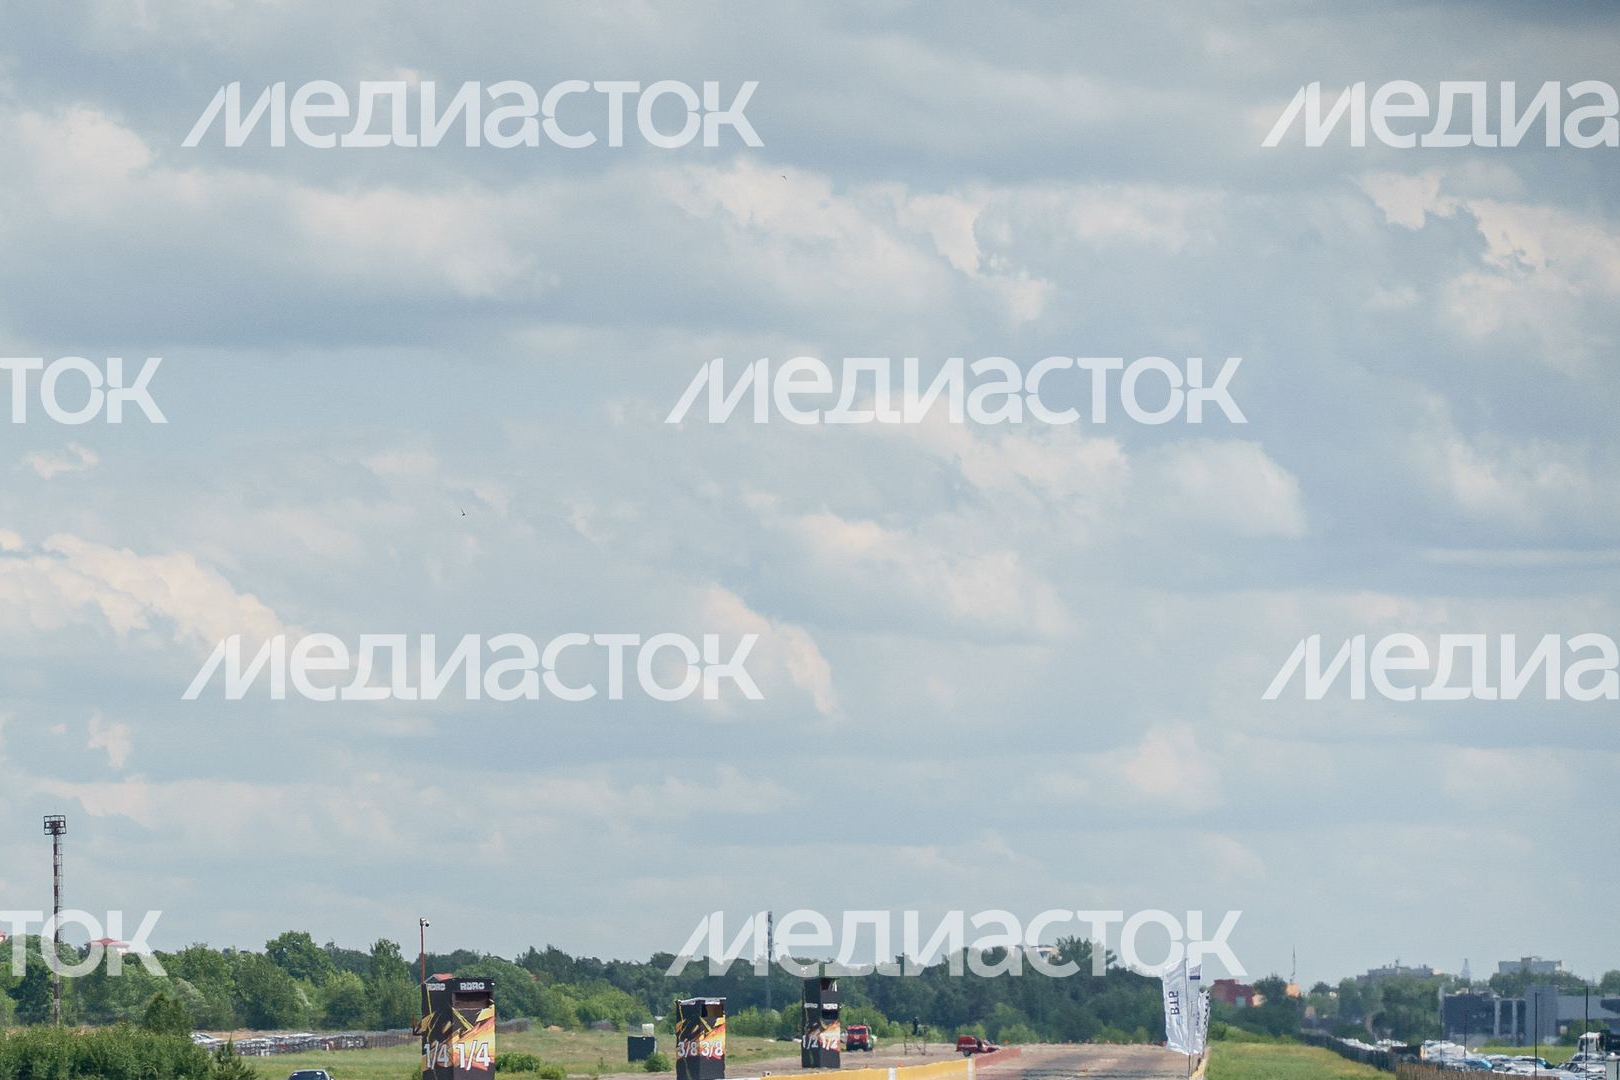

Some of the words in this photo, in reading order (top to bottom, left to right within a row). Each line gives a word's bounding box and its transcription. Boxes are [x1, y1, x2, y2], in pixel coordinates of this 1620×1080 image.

[677, 1040, 698, 1058] 3/8
[700, 1040, 724, 1058] 3/8
[802, 1035, 819, 1049] 1/2
[820, 1035, 839, 1050] 1/2
[423, 1039, 450, 1070] 1/4
[455, 1039, 492, 1071] 1/4
